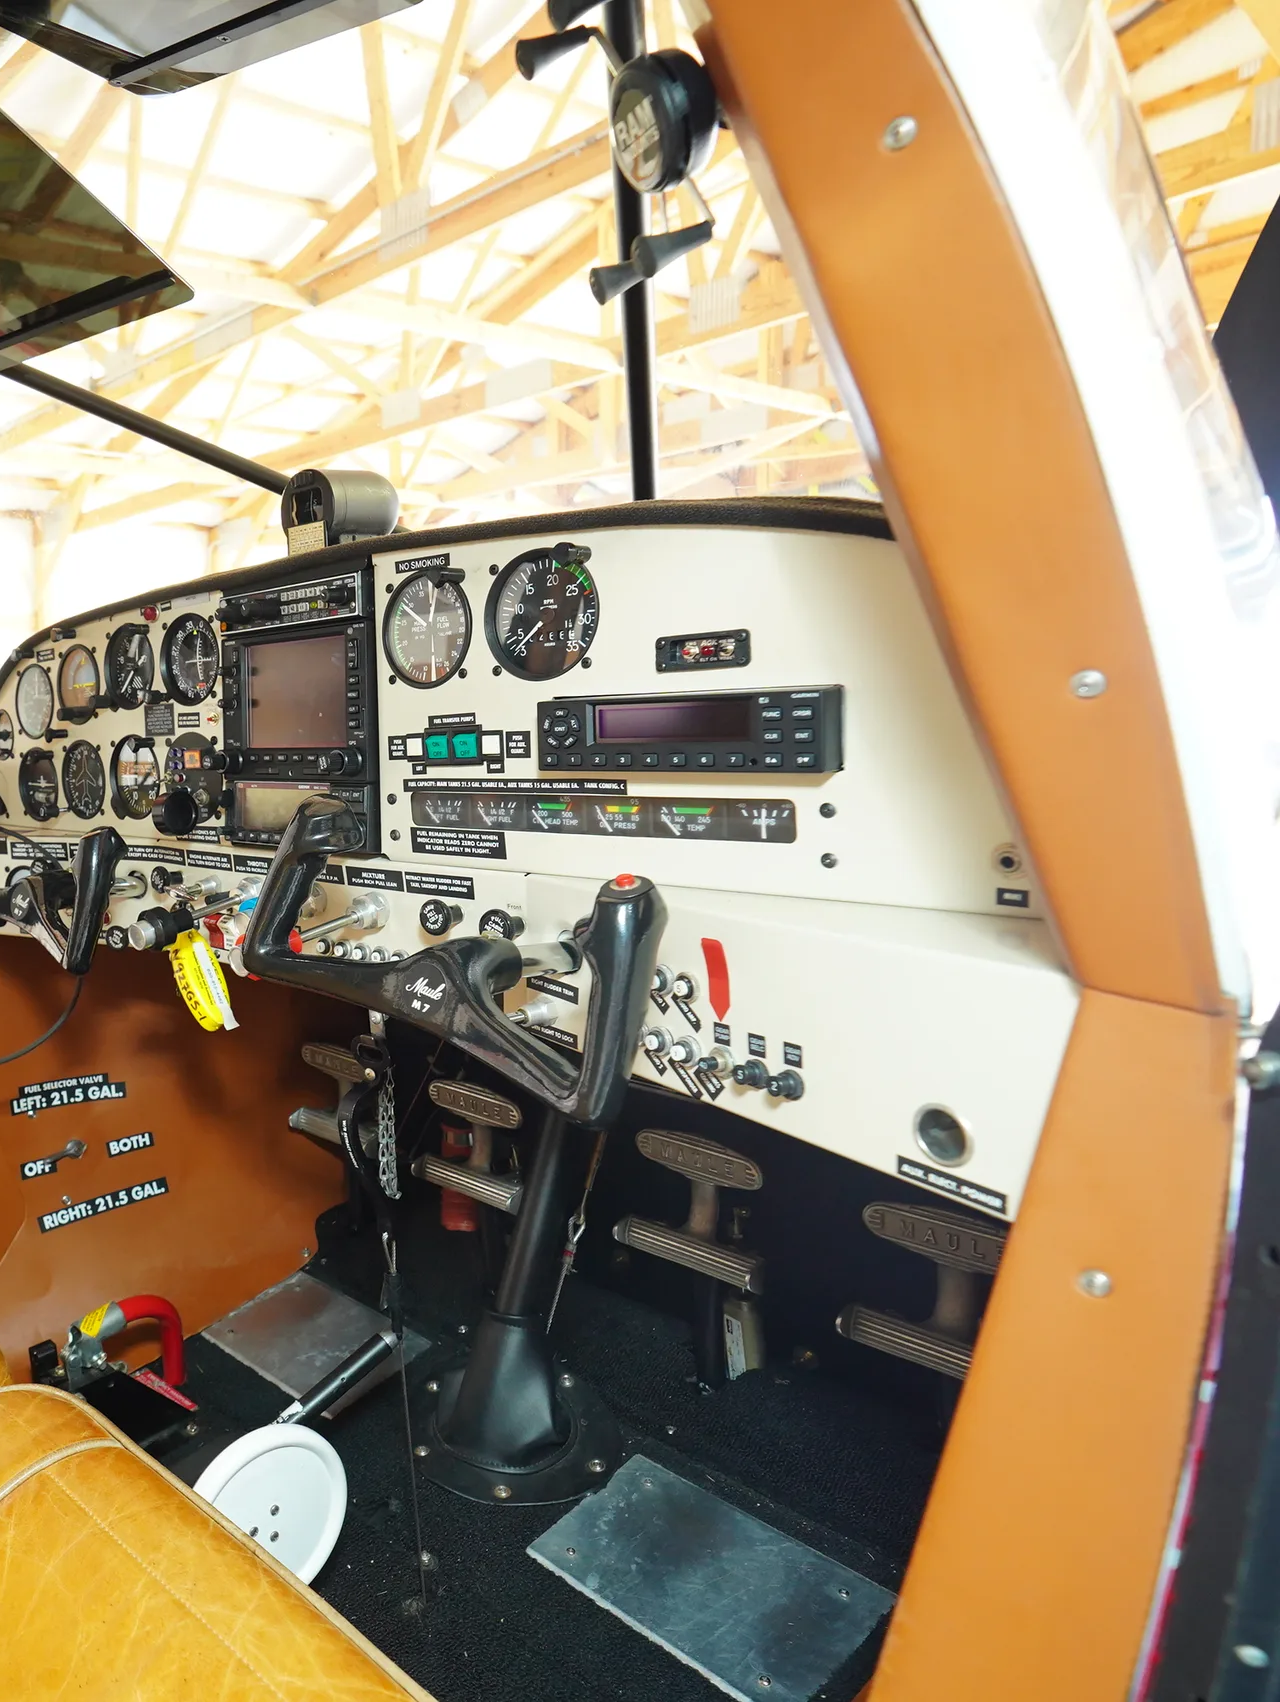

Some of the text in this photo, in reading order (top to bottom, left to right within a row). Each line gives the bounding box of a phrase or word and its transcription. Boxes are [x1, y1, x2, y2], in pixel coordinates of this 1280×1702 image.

[614, 94, 657, 152] RAM
[399, 556, 445, 571] NO SMOKING
[547, 574, 559, 586] 20
[526, 583, 534, 595] 15
[566, 584, 578, 596] 25
[515, 604, 524, 614] 10
[578, 613, 591, 625] 30
[518, 629, 524, 639] 5
[566, 640, 579, 652] 35
[488, 921, 504, 932] CABIN
[491, 916, 504, 927] PULL
[405, 977, 446, 1000] Maule
[544, 982, 562, 992] RUDDER
[563, 988, 574, 996] TRIM
[411, 999, 430, 1012] M 7
[541, 1027, 554, 1036] RIGHT
[562, 1035, 574, 1043] LOCK
[314, 1052, 360, 1076] MAULE
[24, 1075, 103, 1094] FUEL SELECTOR VALVE
[771, 1082, 778, 1091] 2
[13, 1084, 123, 1114] LEFT: 21.5 GAL.
[446, 1092, 502, 1119] MAULE
[109, 1133, 150, 1156] BOTH
[661, 1140, 734, 1178] MAULE
[24, 1162, 52, 1177] OFF
[43, 1181, 165, 1230] RIGHT: 21.5 GAL.
